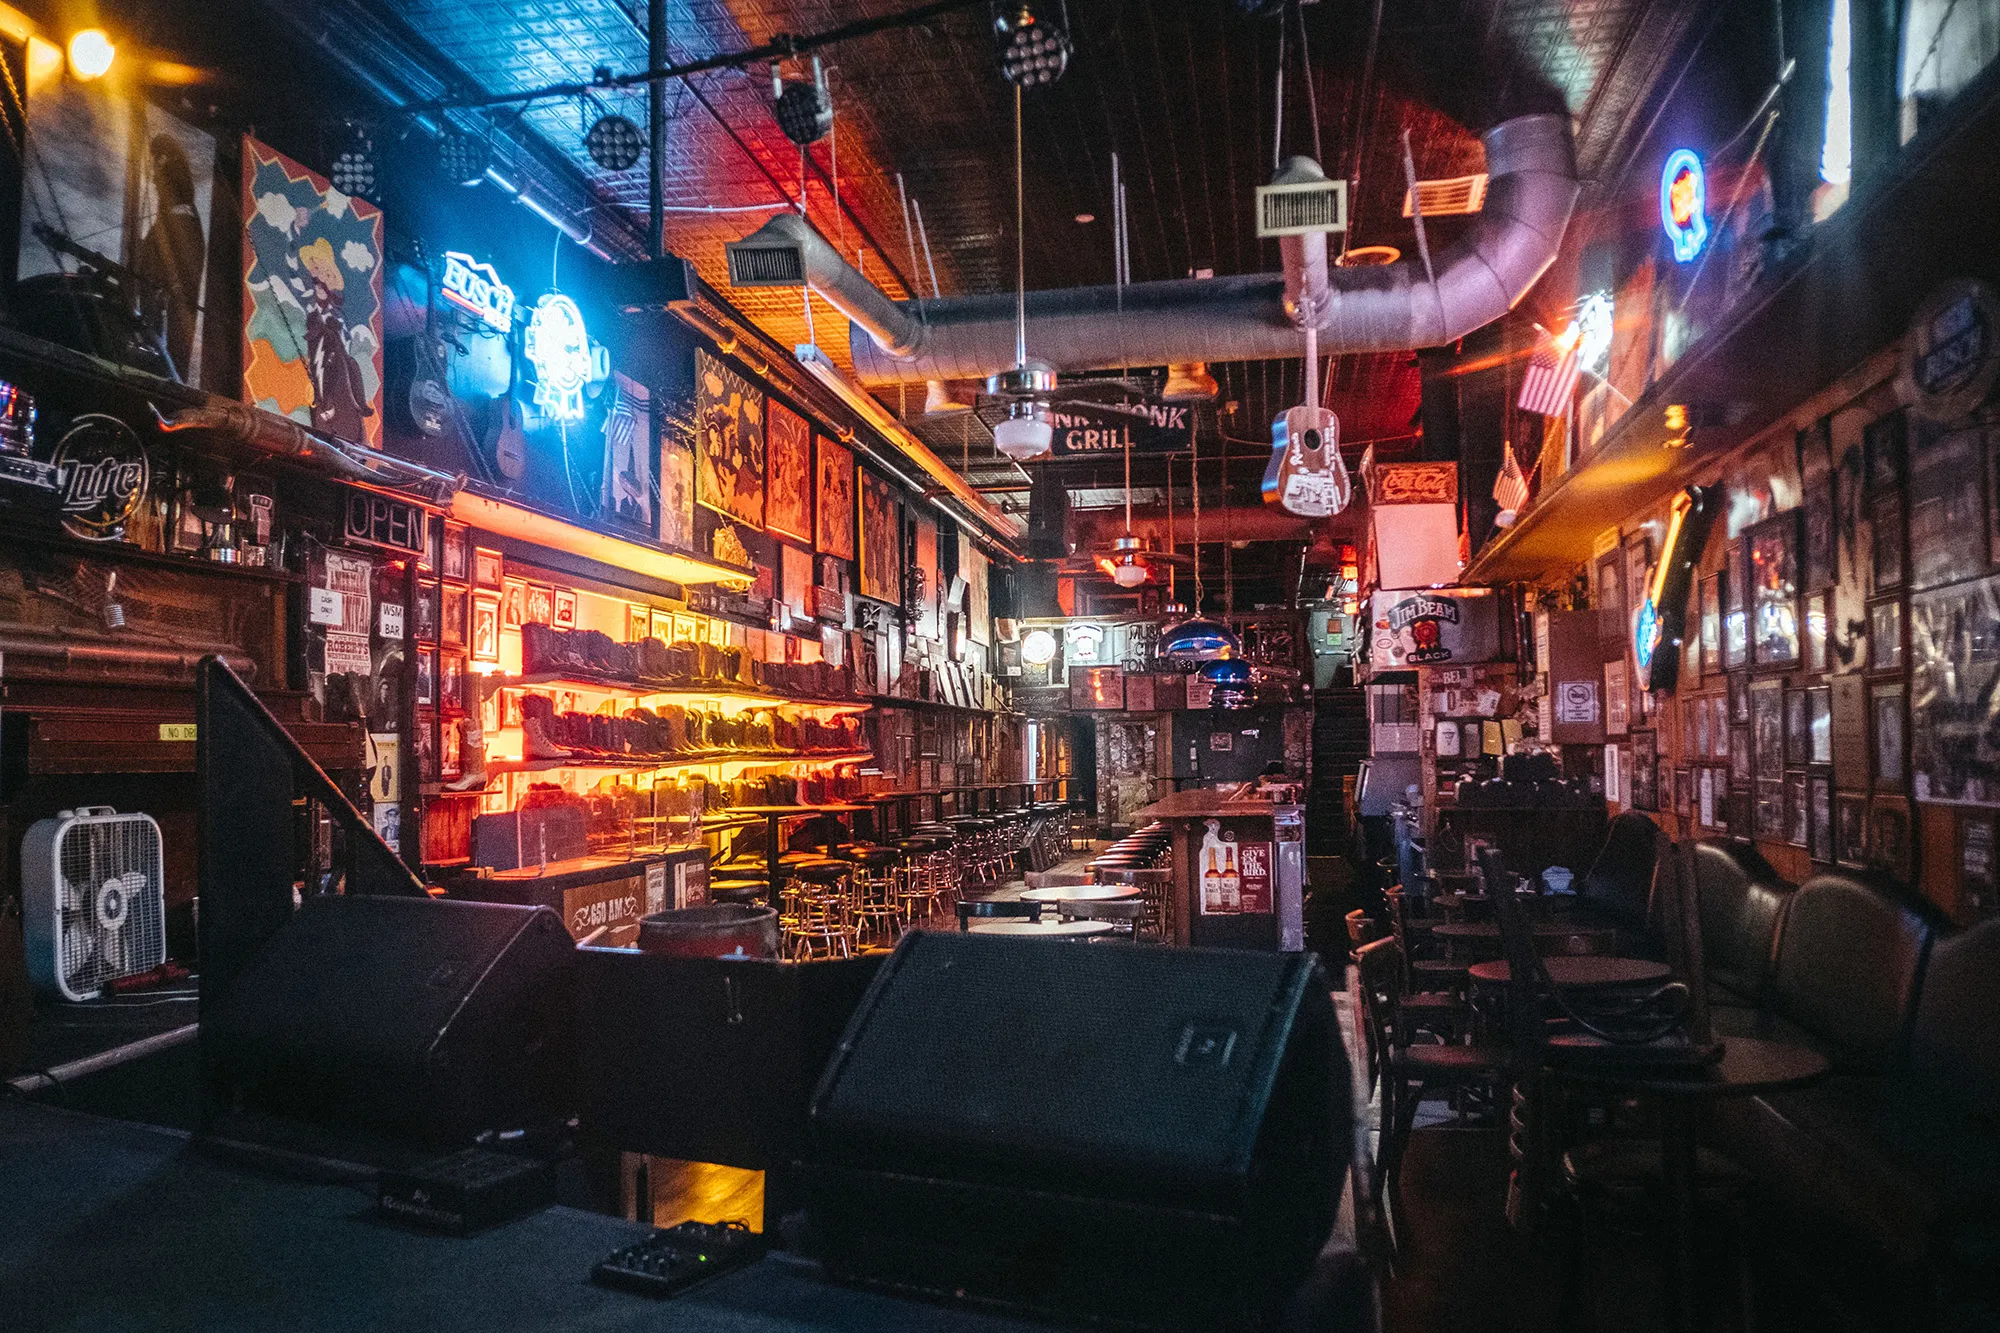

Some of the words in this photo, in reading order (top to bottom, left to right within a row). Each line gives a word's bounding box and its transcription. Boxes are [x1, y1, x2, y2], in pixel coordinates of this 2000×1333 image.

[442, 257, 512, 320] BUSCH
[60, 456, 142, 511] Lite
[350, 494, 424, 551] OPEN
[383, 604, 402, 618] WSM
[1391, 603, 1418, 630] JIM
[1415, 596, 1457, 621] BEAM
[384, 624, 400, 636] BAR
[1408, 650, 1449, 662] BLACK
[168, 727, 179, 738] NO
[183, 727, 197, 738] DR
[1242, 849, 1265, 857] GIVE
[1243, 862, 1262, 870] THE
[590, 902, 607, 926] 650
[608, 897, 623, 922] AM
